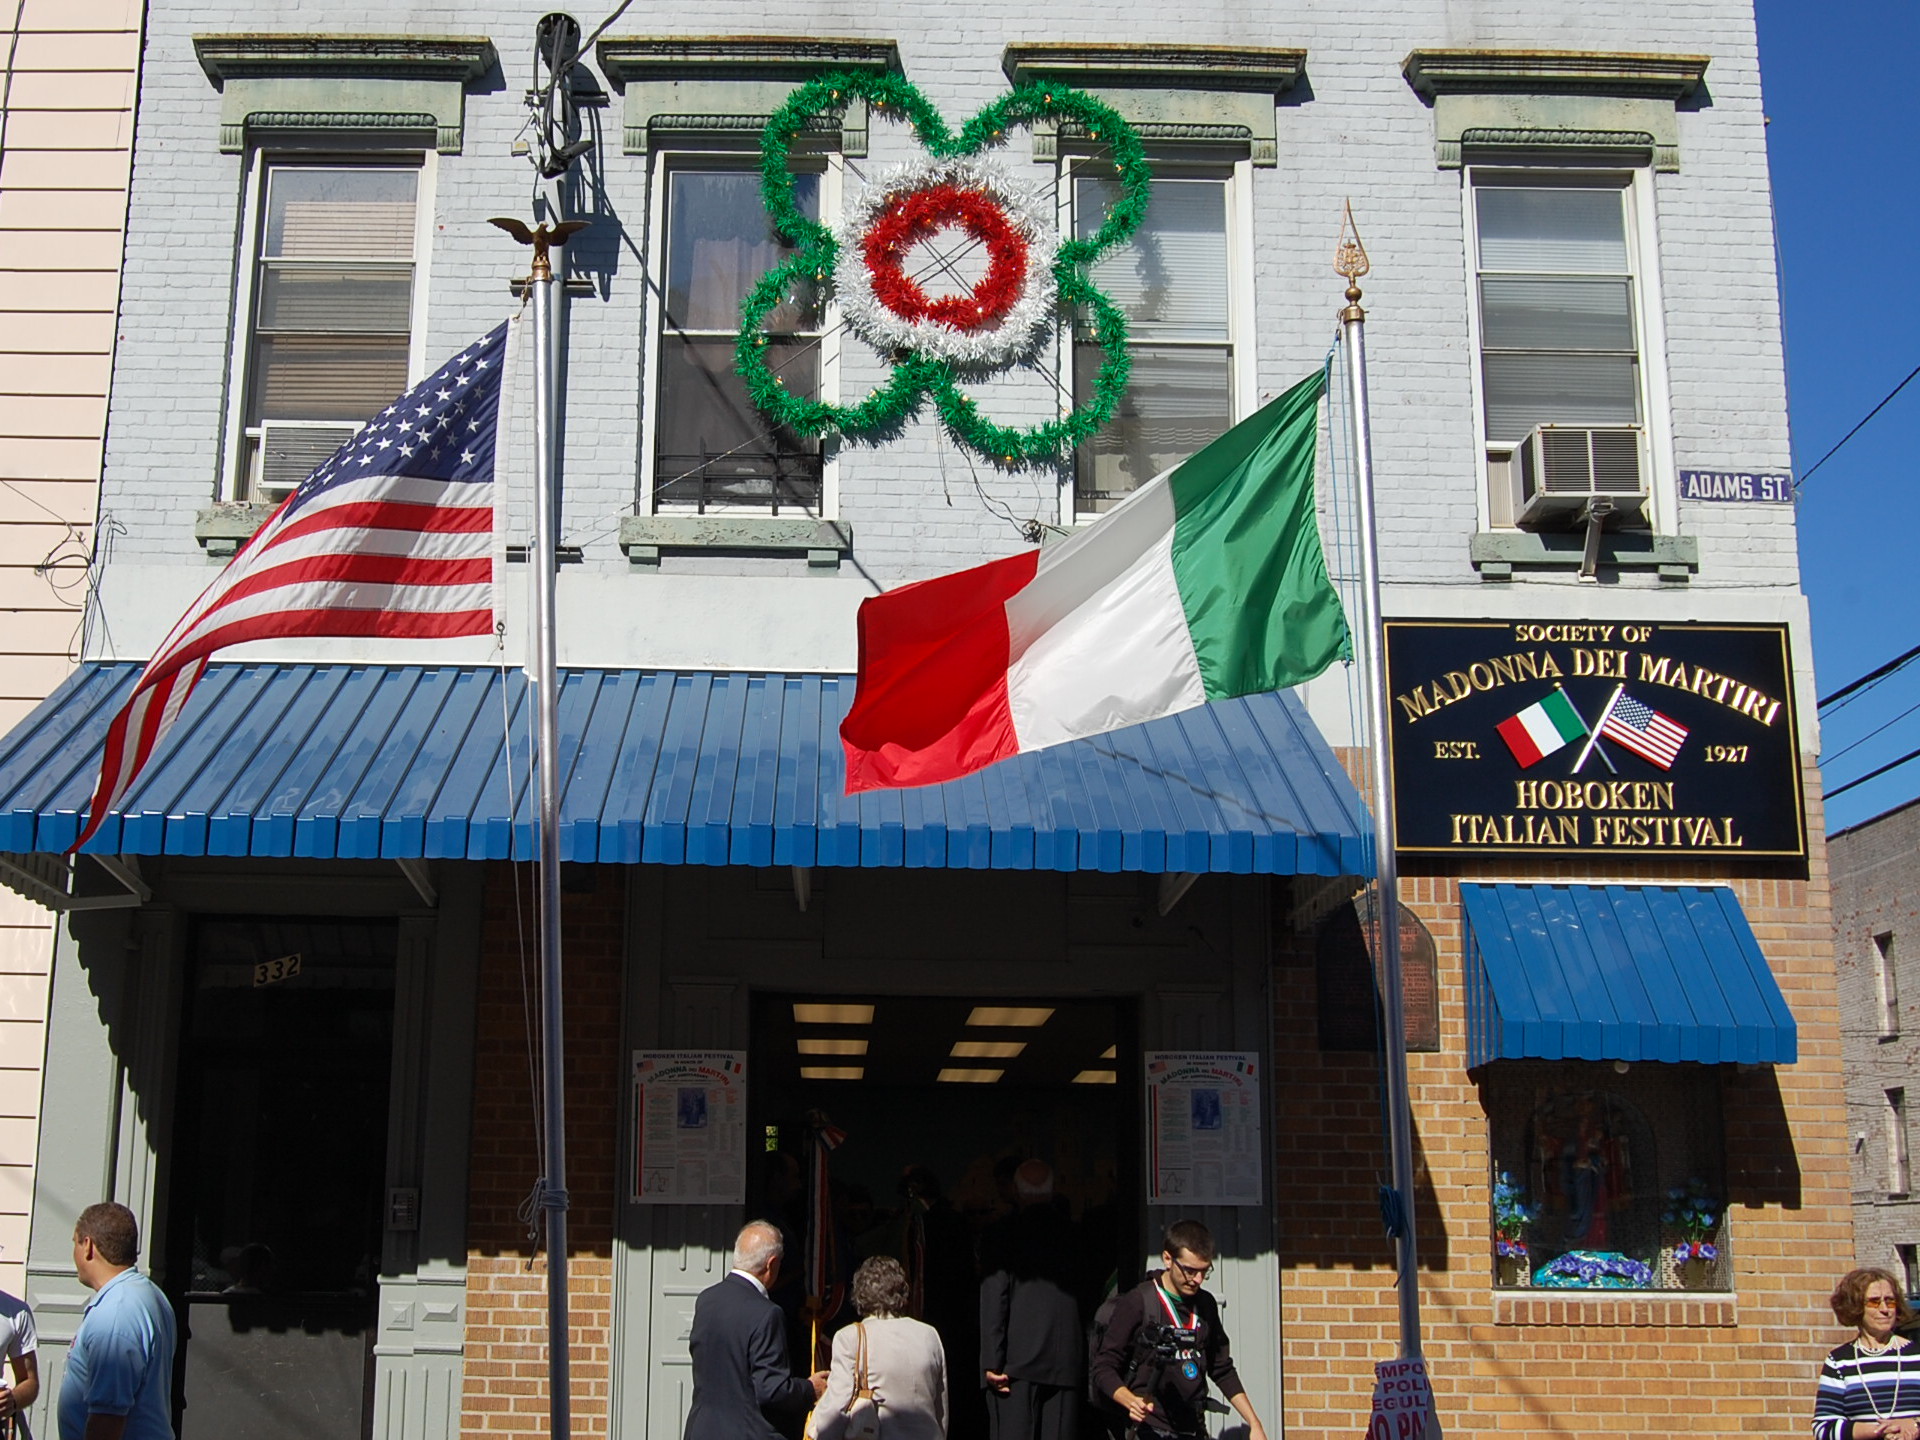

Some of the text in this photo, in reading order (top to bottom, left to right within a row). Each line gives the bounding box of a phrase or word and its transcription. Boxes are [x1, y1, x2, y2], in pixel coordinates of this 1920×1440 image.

[1688, 474, 1788, 501] ADAMS ST.
[1515, 625, 1653, 643] SOCIETY OF
[1396, 647, 1782, 727] MADONNA DEI MARTIRI
[1433, 741, 1481, 760] EST.
[1704, 745, 1749, 763] 1927
[1514, 780, 1674, 811] HOBOKEN
[1450, 814, 1743, 847] ITALIAN FESTIVAL
[256, 956, 299, 984] 332
[648, 1066, 687, 1083] MADONNA
[698, 1067, 730, 1086] MARTIRI
[1160, 1067, 1200, 1085] MADONNA
[1372, 1395, 1429, 1411] EGUL
[1397, 1411, 1428, 1440] PA
